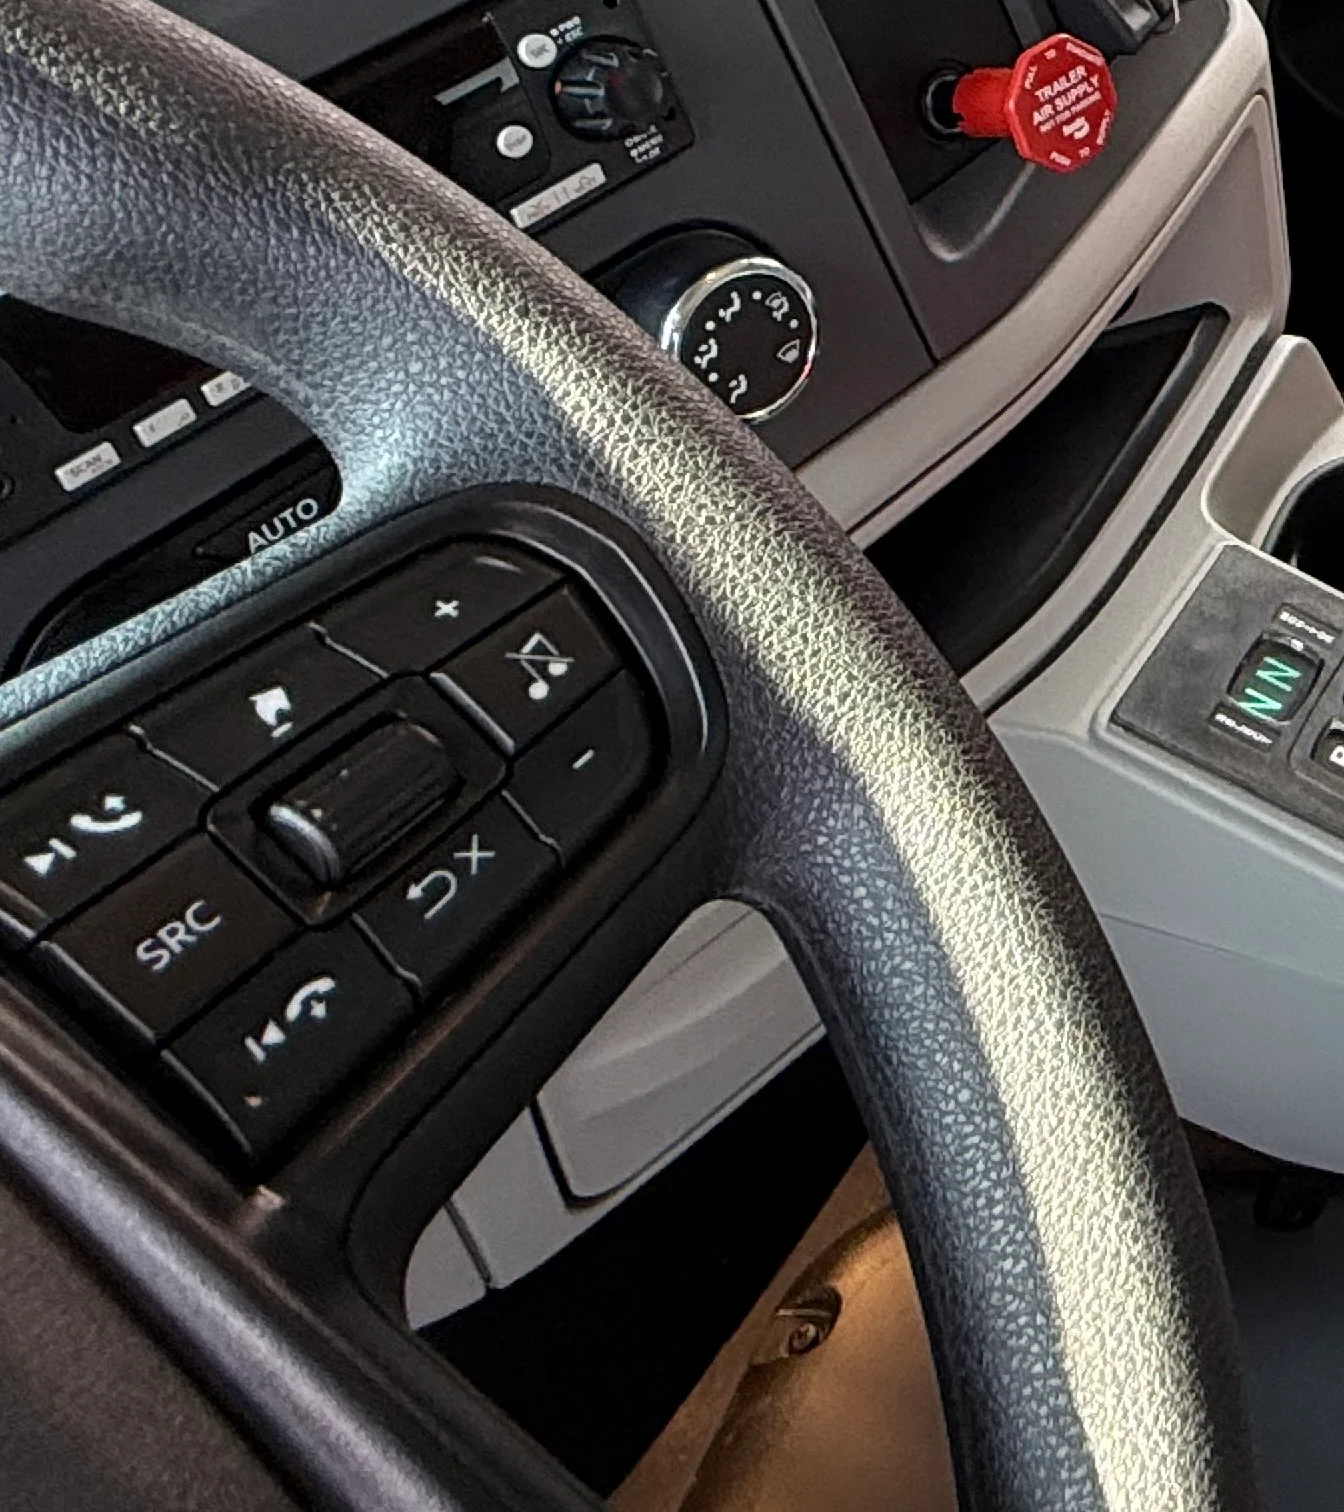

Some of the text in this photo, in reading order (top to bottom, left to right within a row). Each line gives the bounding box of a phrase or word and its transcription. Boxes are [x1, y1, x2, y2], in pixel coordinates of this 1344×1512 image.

[1033, 73, 1100, 126] AIR SUPPLY
[1034, 65, 1088, 102] TRAILER
[248, 498, 319, 555] AUTO
[136, 899, 222, 972] SRC
